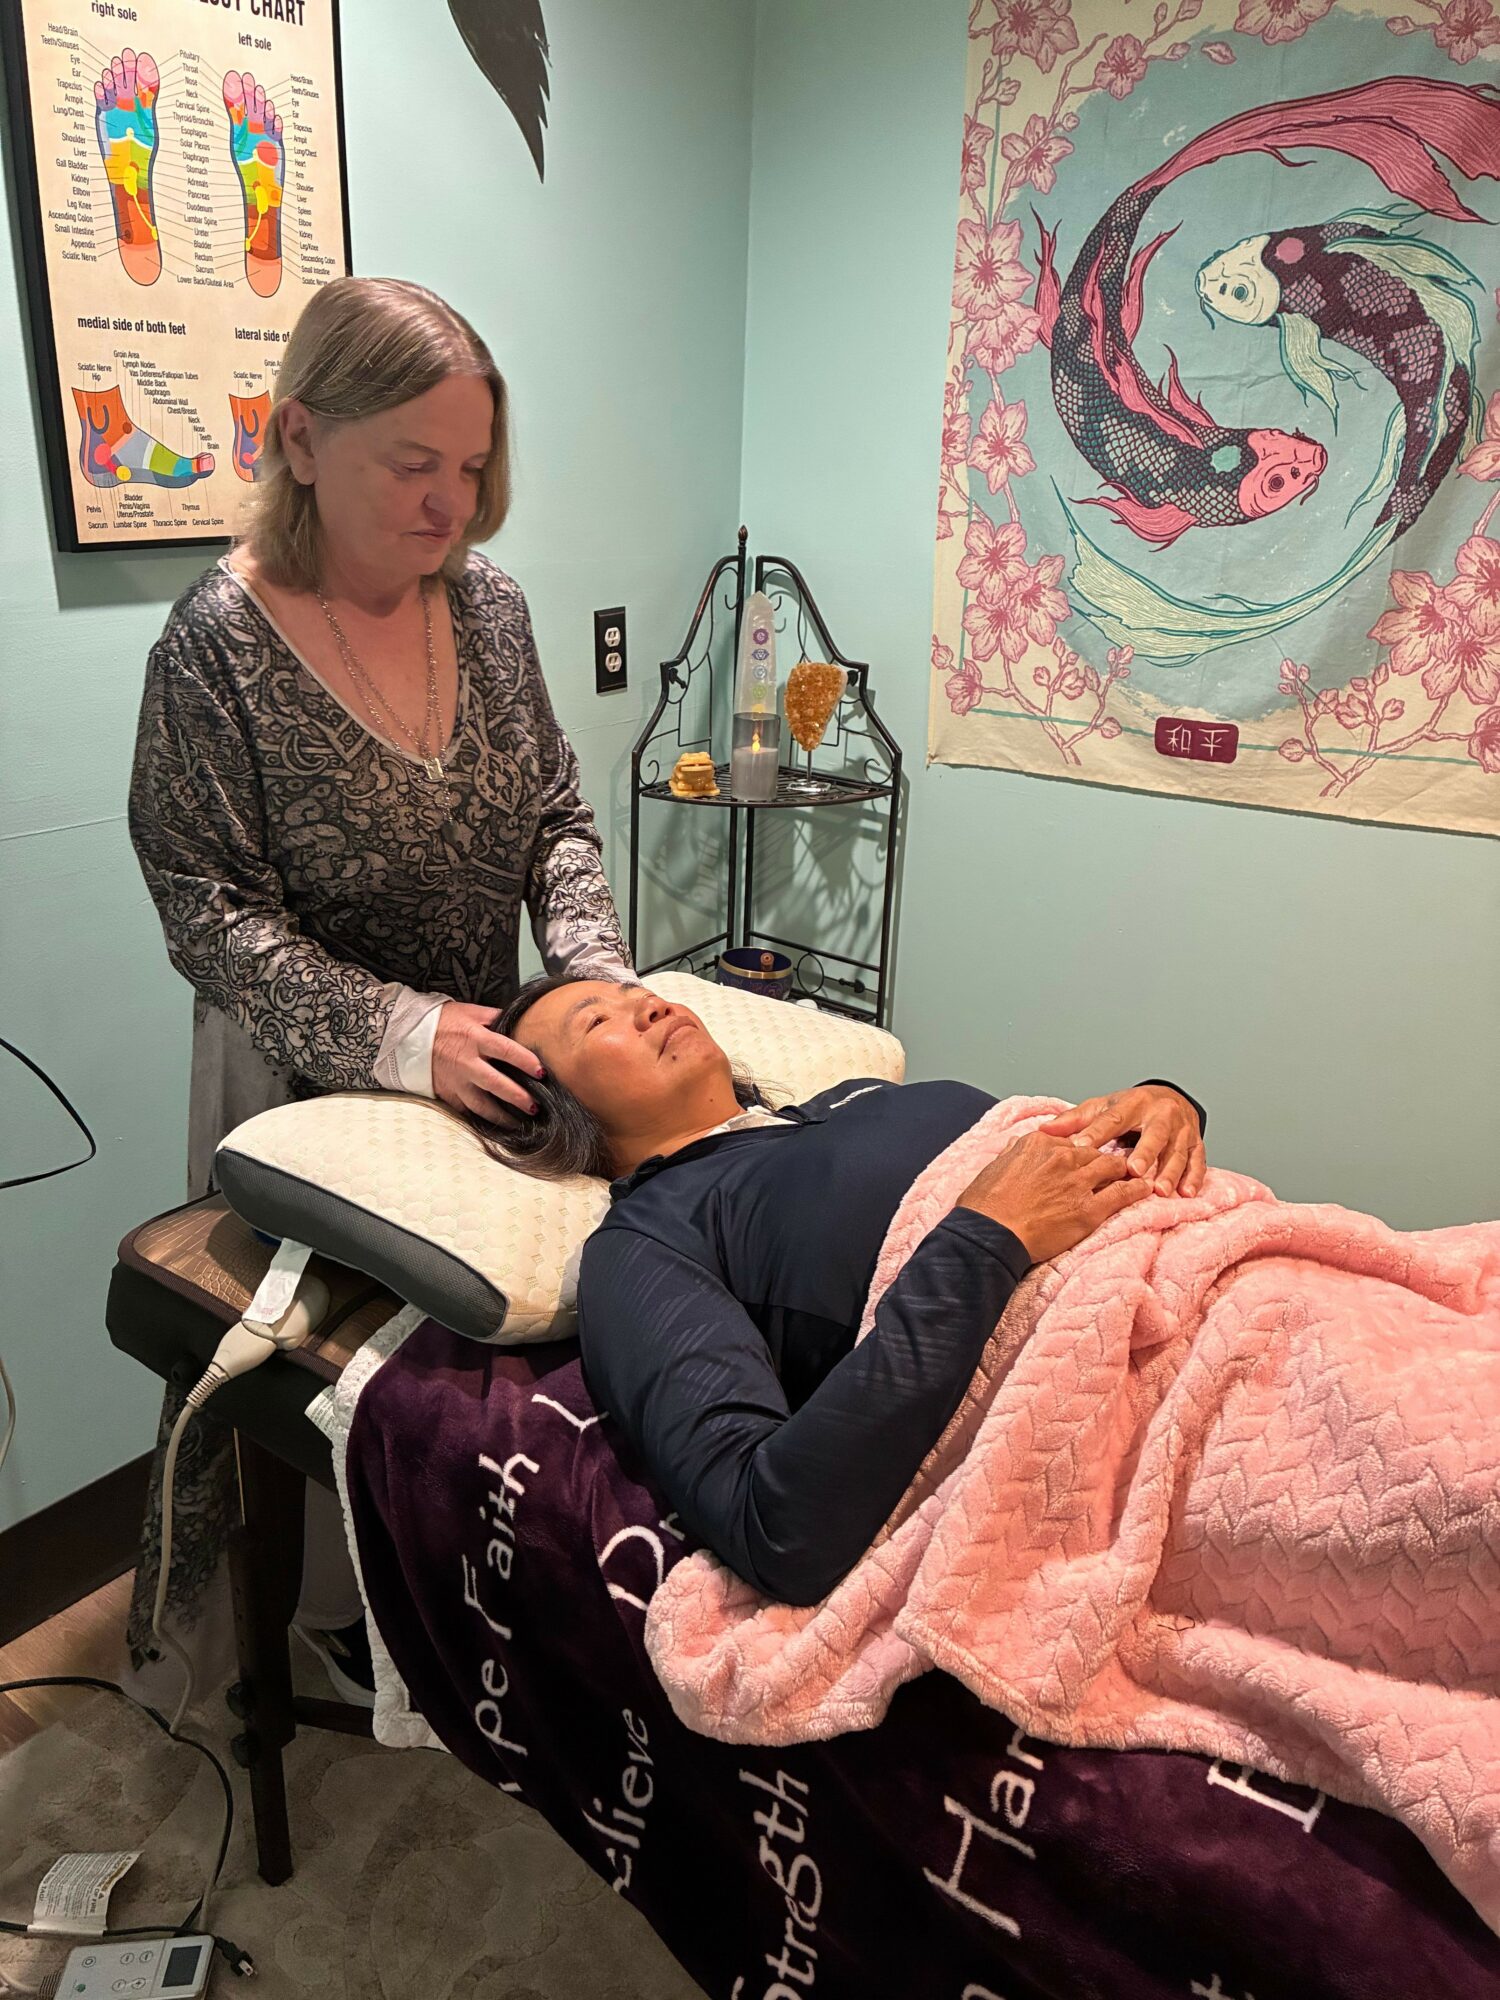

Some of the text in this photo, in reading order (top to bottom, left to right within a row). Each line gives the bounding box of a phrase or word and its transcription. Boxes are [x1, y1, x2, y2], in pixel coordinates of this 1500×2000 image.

[91, 0, 137, 21] right sole
[250, 0, 305, 26] CHART
[47, 22, 79, 37] Head/Brain
[40, 34, 80, 51] Teeth/Sinuses
[238, 32, 272, 51] left sole
[70, 54, 81, 65] Eye
[179, 49, 201, 63] Pituitary
[71, 67, 81, 78] Ear
[182, 62, 199, 74] Throat
[56, 78, 83, 92] Trapezius
[184, 76, 198, 87] Nose
[64, 93, 84, 105] Armpit
[185, 89, 199, 99] Neck
[52, 104, 84, 118] Lung/Chest
[175, 99, 211, 114] Cervical Spine
[73, 121, 86, 131] Arm
[180, 125, 208, 139] Esophagus
[61, 132, 86, 144] Shoulder
[179, 138, 193, 149] Solar
[73, 147, 87, 157] Liver
[182, 151, 210, 165] Diaphragm
[67, 159, 89, 171] Bladder
[185, 164, 209, 176] Stomach
[71, 173, 90, 186] Kidney
[187, 177, 209, 189] Adrenals
[187, 189, 211, 202] Pancreas
[66, 199, 78, 210] Leg
[186, 201, 214, 214] Duodenum
[48, 210, 94, 223] Ascending Colon
[183, 213, 218, 227] Lumbar Spine
[54, 223, 95, 237] Small Intestine
[70, 238, 97, 249] Appendix
[193, 239, 213, 250] Bladder
[61, 250, 98, 262] Sciatic Nerve
[194, 252, 214, 263] Rectum
[195, 264, 215, 275] Sacrum
[176, 274, 193, 285] Lower
[77, 316, 187, 336] medial side of both feet
[234, 327, 291, 343] lateral side of
[127, 350, 141, 359] Area
[77, 362, 113, 373] Sciatic Nerve
[122, 360, 157, 369] Lymph Nodes
[91, 372, 103, 382] Hip
[183, 371, 200, 380] Tubes
[136, 379, 168, 388] Middle Back
[143, 387, 172, 398] Diaphragm
[152, 397, 190, 406] Abdominal Wall
[166, 406, 199, 416] Chest/Breast
[187, 415, 201, 424] Neck
[192, 424, 207, 433] Nose
[199, 433, 213, 441] Teeth
[206, 442, 221, 451] Brain
[124, 493, 143, 502] Bladder
[86, 505, 102, 513] Pelvis
[118, 502, 151, 511] Penis/Vagina
[181, 503, 201, 512] Thymus
[116, 510, 155, 518] Uterus/Prostate
[87, 521, 109, 530] Sacrum
[112, 520, 148, 530] Lumbar Spine
[152, 518, 188, 527] Thoracic Spine
[191, 517, 225, 527] Cervical Spine
[1164, 723, 1230, 758] 和平
[461, 1453, 541, 1640] Faith
